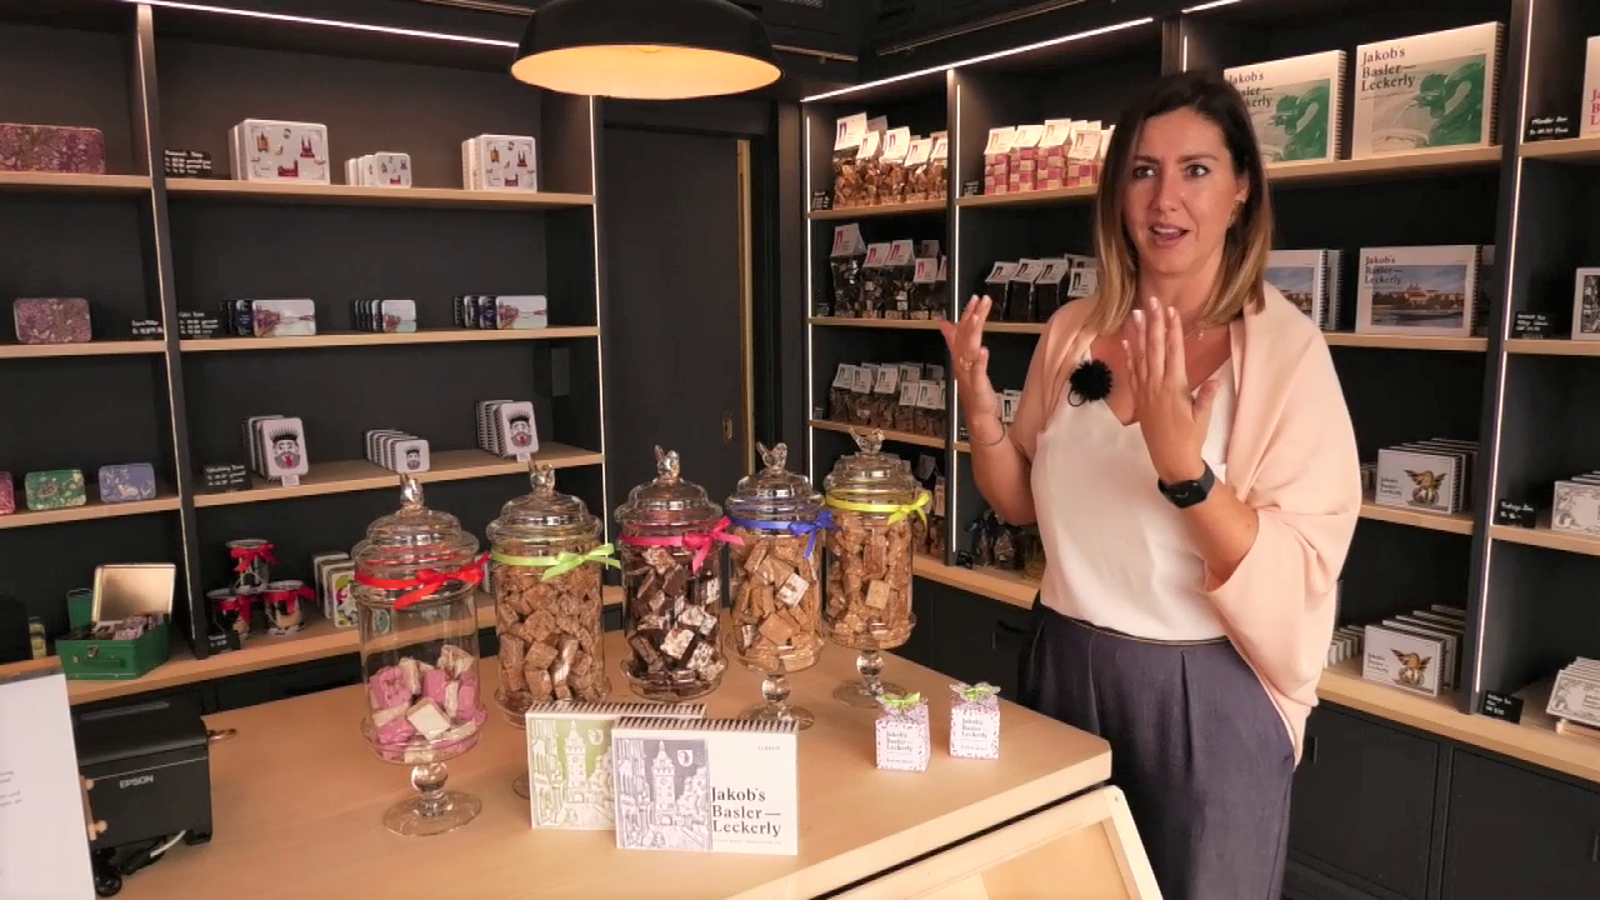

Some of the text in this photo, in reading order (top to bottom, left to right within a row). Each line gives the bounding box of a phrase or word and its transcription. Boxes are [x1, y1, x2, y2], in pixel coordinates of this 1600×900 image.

[1361, 46, 1405, 67] Jakob's
[1362, 74, 1415, 91] Leckerly
[119, 775, 154, 789] EPSON
[711, 786, 767, 803] Jakob's
[712, 820, 782, 838] Leckerly
